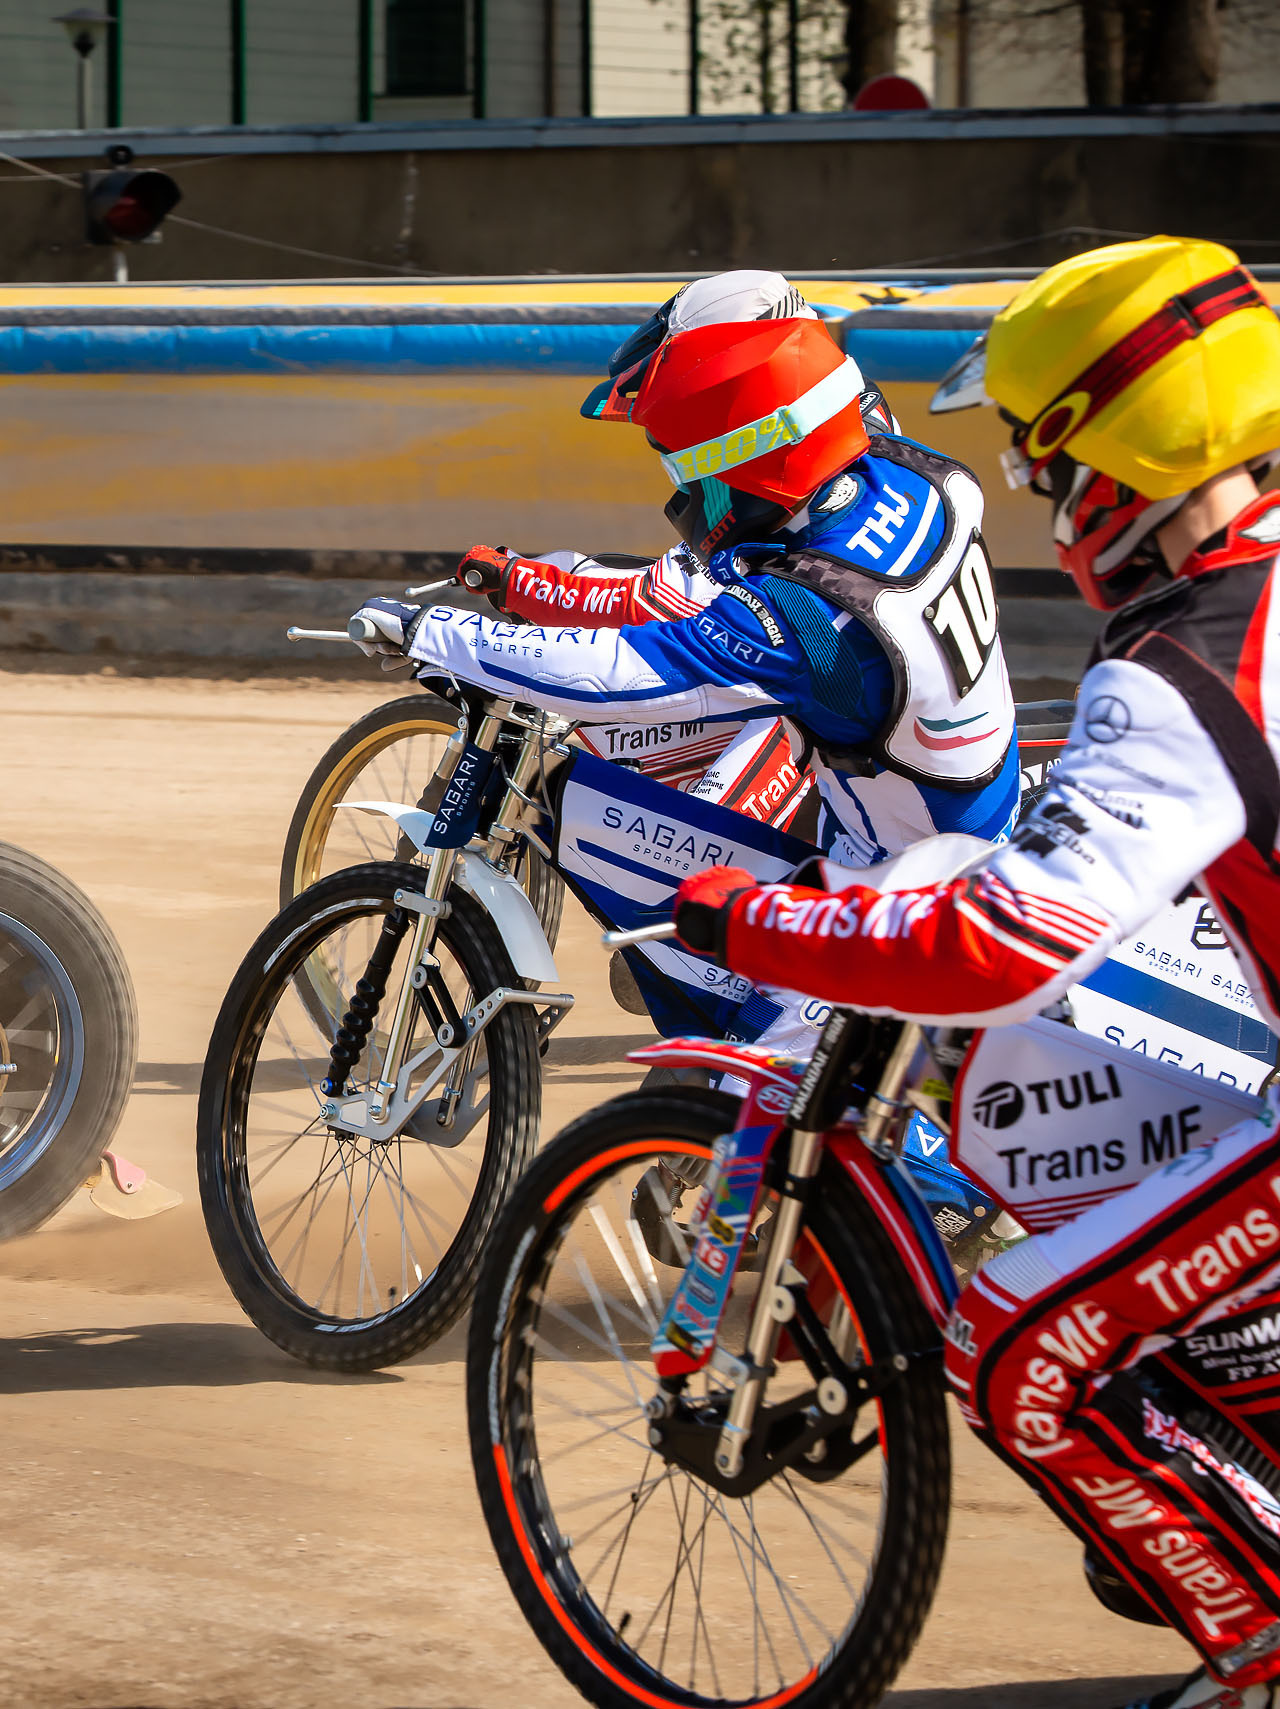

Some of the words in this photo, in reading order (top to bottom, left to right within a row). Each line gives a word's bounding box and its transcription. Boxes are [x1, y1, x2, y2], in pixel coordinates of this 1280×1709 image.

[677, 410, 799, 479] 100%
[699, 510, 737, 554] SCOTT
[846, 484, 912, 560] THJ
[515, 566, 578, 609] Trans
[582, 585, 626, 615] MF
[932, 543, 995, 684] 10
[430, 607, 599, 645] SAGARI
[470, 638, 543, 658] SPORTS
[698, 617, 764, 665] GARI
[605, 724, 672, 754] Trans
[434, 752, 479, 834] SAGARI
[603, 806, 735, 868] SAGARI
[633, 844, 691, 872] SPORTS
[746, 884, 861, 939] Trans
[1134, 941, 1202, 978] SAGARI
[1028, 1064, 1122, 1115] TULI
[1001, 1140, 1125, 1188] Trans
[1141, 1105, 1202, 1165] MF
[1136, 1208, 1279, 1313] Trans
[1143, 1527, 1255, 1642] Trans
